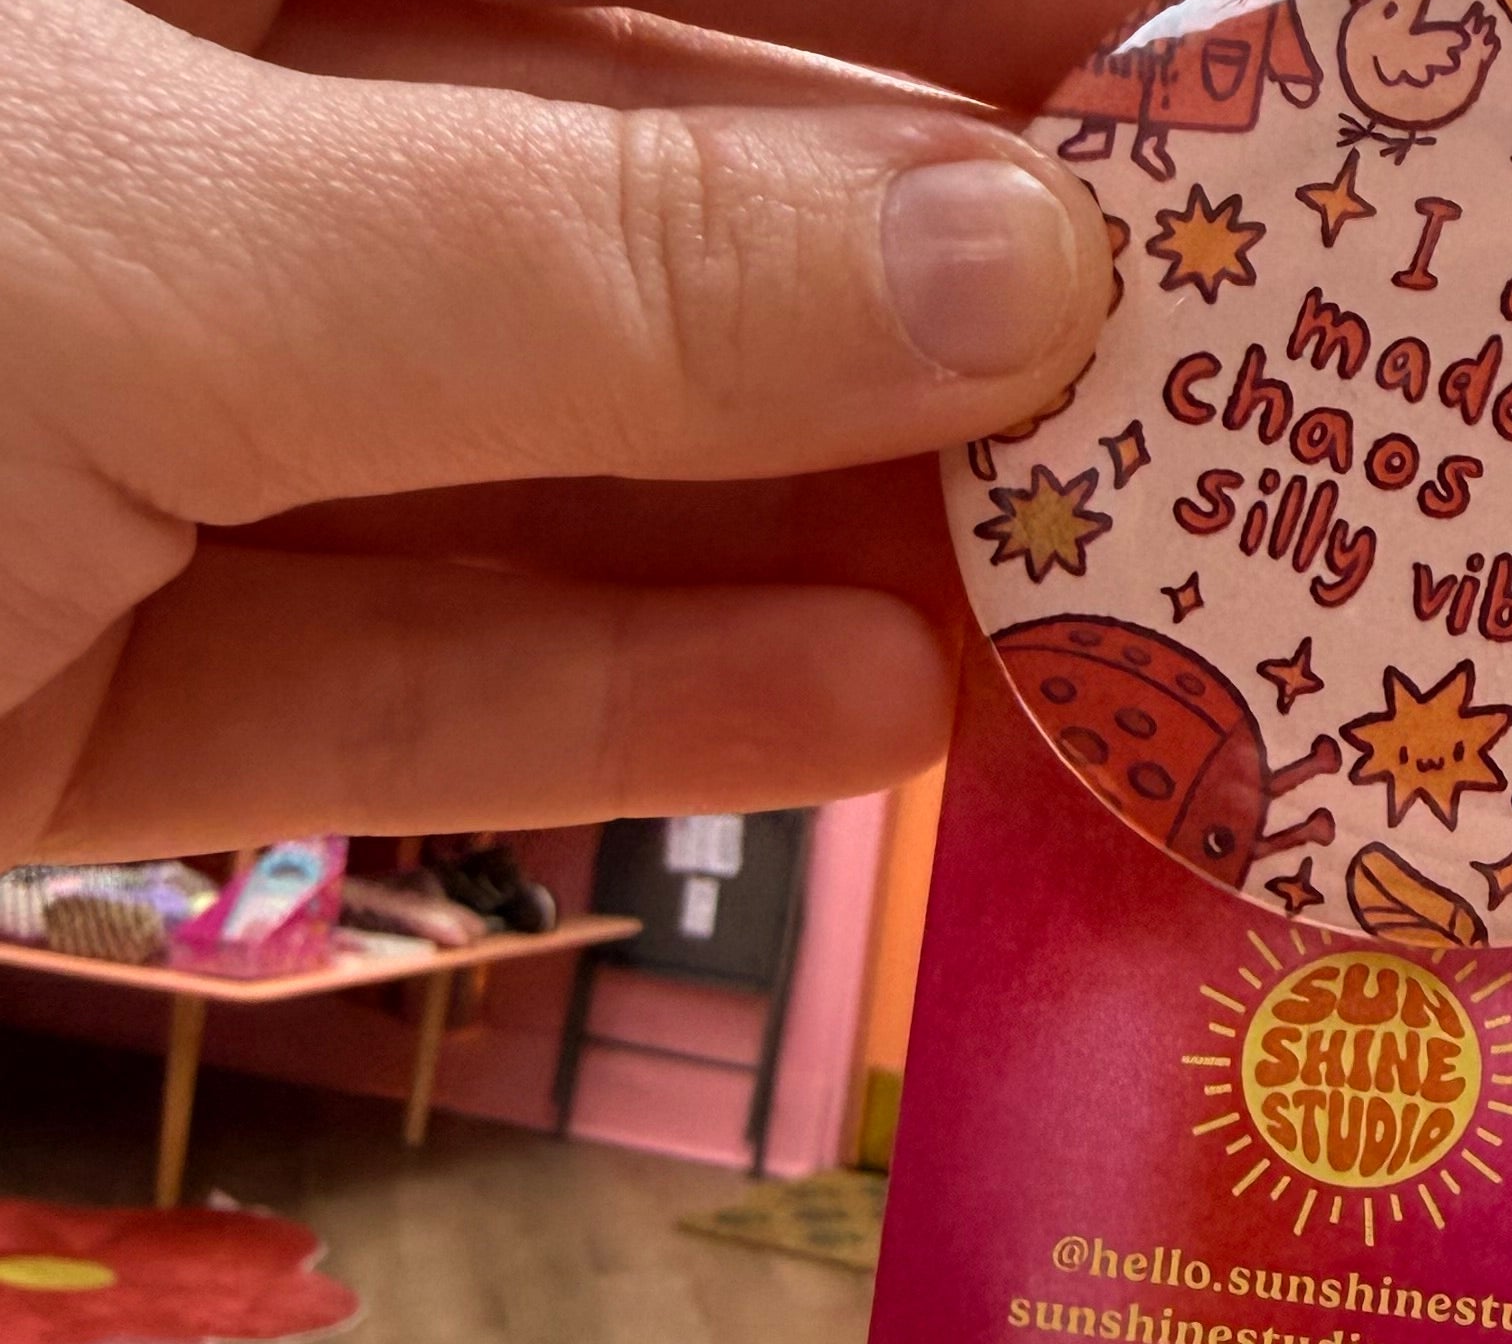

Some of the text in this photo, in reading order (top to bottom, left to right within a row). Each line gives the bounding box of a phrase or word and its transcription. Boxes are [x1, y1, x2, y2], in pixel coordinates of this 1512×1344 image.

[1391, 196, 1463, 291] I
[1162, 343, 1484, 519] chaos
[1173, 467, 1377, 608] silly
[1271, 962, 1466, 1040] SUN
[1254, 1026, 1467, 1104] SHINE
[1260, 1088, 1456, 1178] STUDIO
